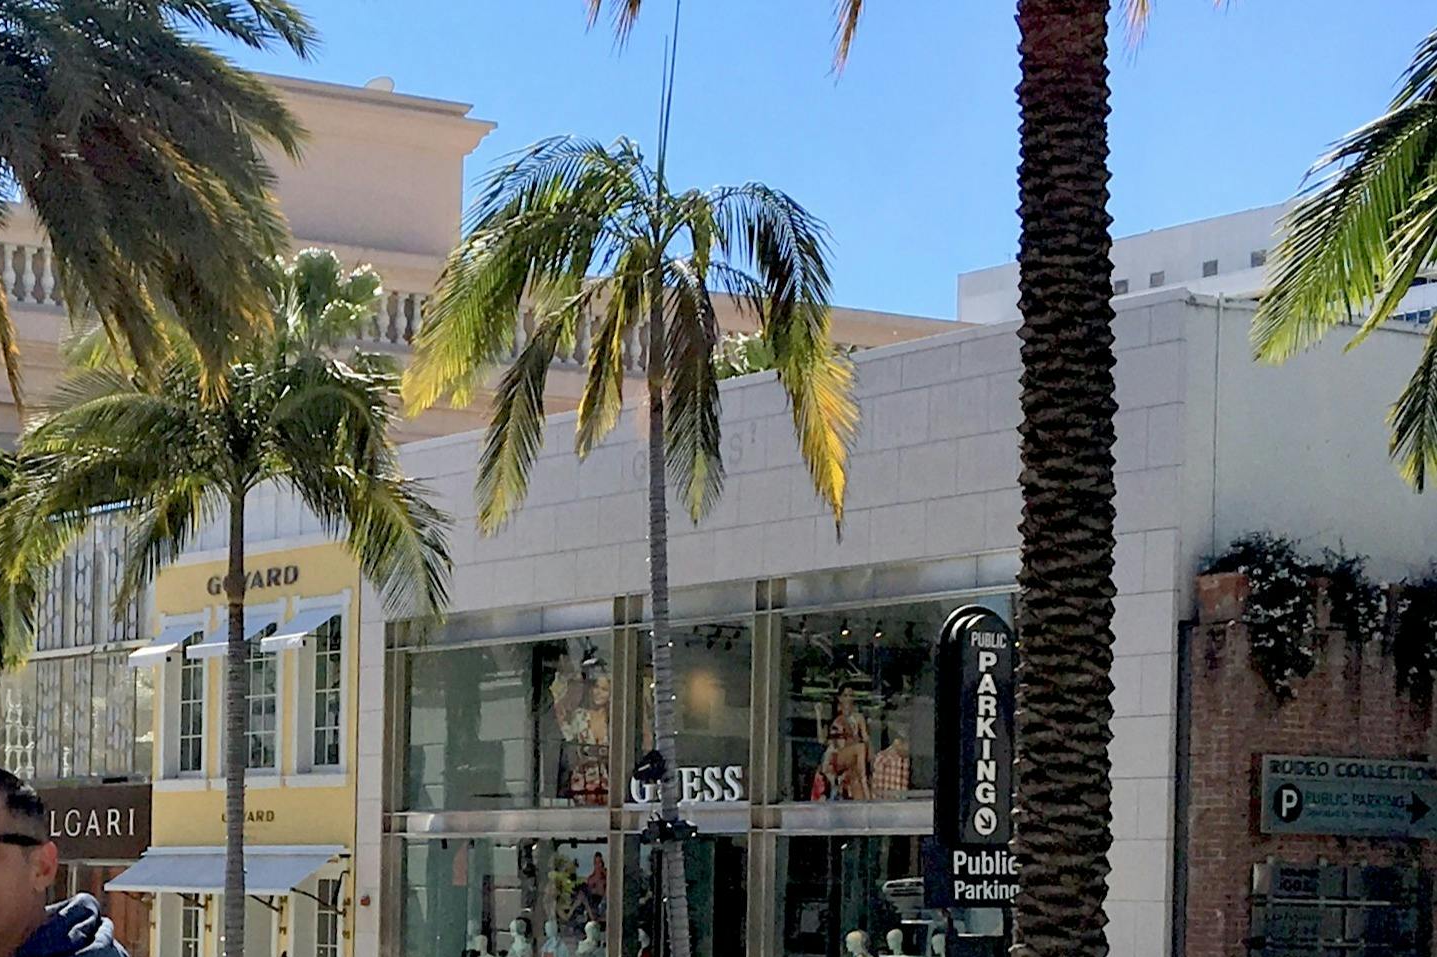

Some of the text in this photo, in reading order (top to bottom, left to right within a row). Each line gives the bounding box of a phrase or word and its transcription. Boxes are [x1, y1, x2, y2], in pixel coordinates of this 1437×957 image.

[970, 631, 1007, 648] PUBLIC
[975, 651, 998, 804] PARKING
[1269, 759, 1330, 777] RODEO
[631, 766, 744, 803] GESS
[953, 850, 1018, 875] Public
[954, 880, 1021, 904] Parking
